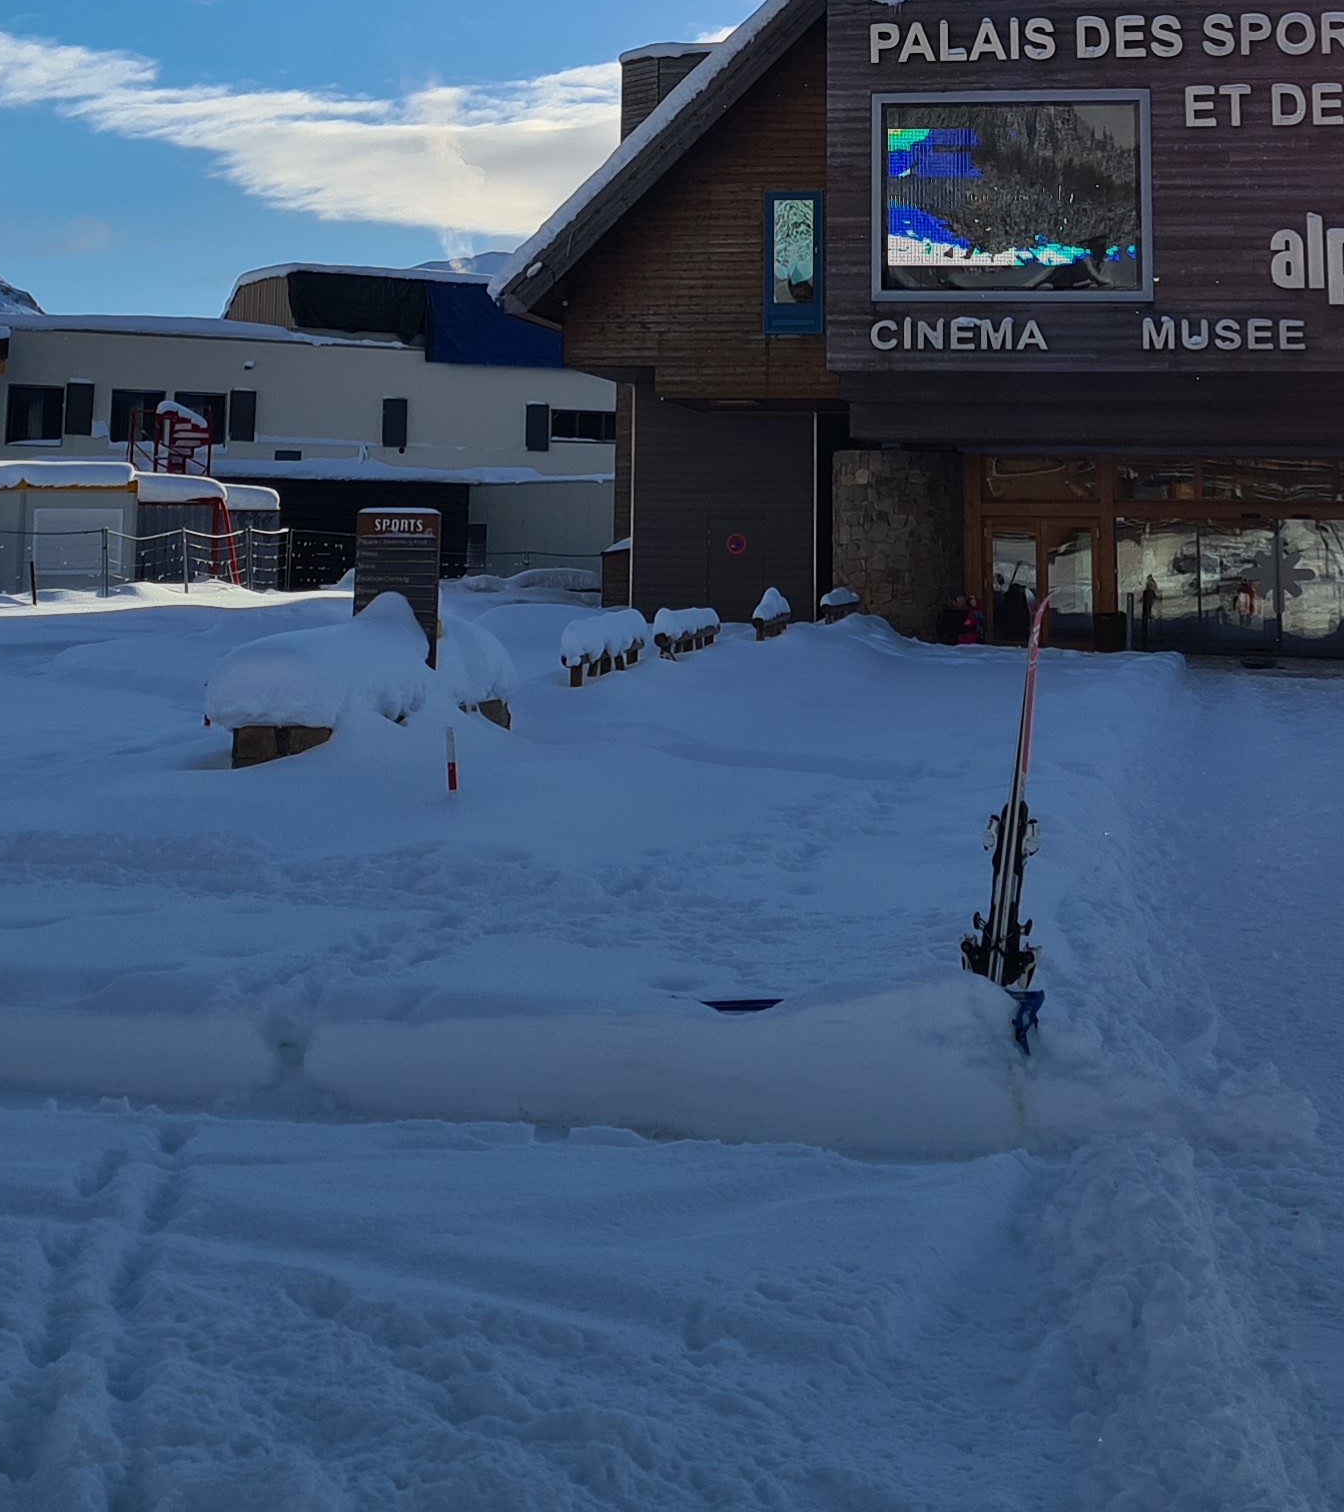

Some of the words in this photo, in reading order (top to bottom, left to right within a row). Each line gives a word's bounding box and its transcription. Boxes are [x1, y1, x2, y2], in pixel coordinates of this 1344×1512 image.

[869, 17, 1057, 64] PALAIS
[1075, 14, 1184, 59] DES
[1184, 83, 1253, 127] ET
[869, 316, 1050, 351] CINEMA
[1141, 316, 1308, 351] MUSEE
[374, 518, 424, 532] SPORTS
